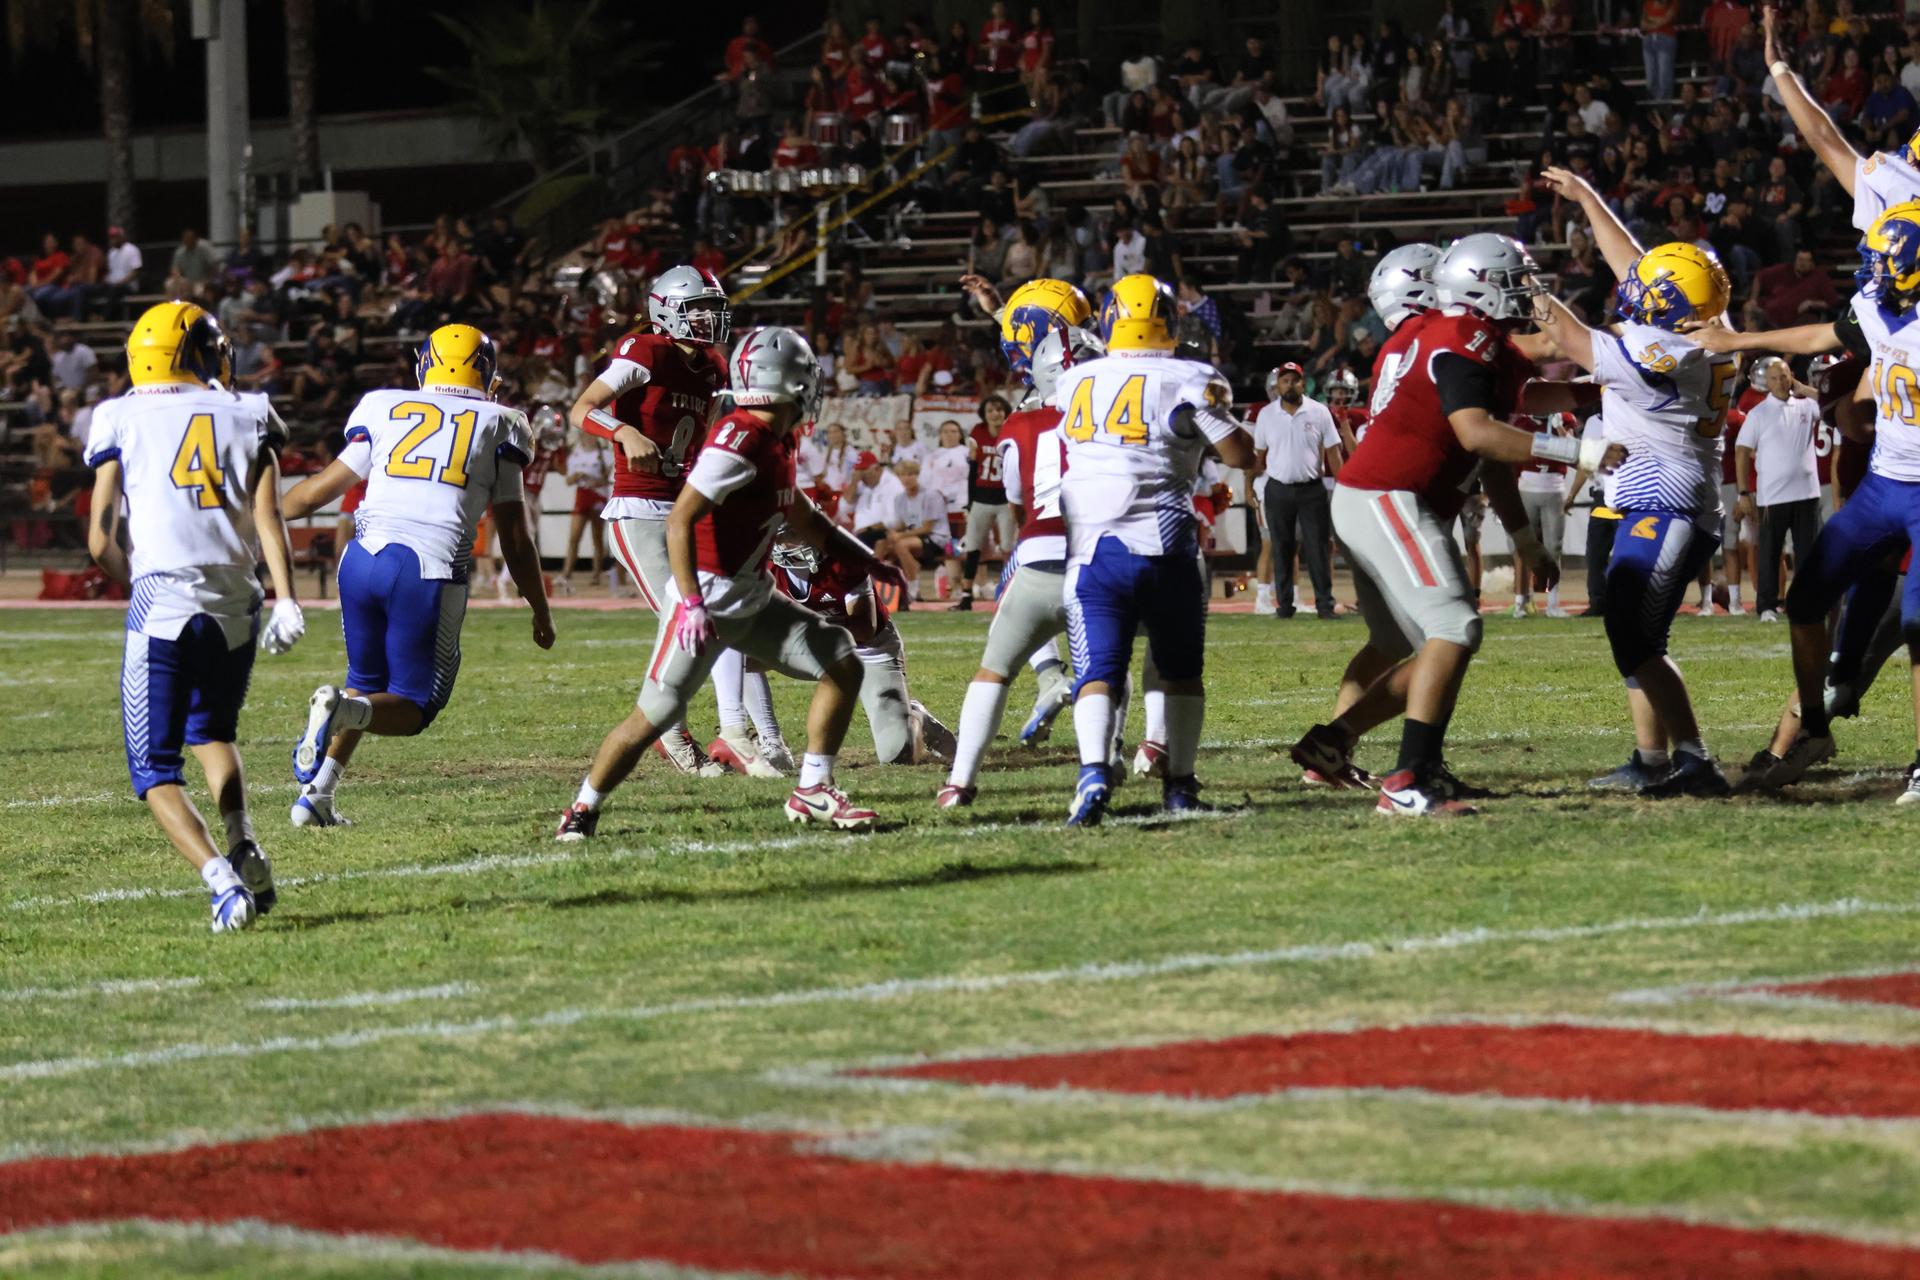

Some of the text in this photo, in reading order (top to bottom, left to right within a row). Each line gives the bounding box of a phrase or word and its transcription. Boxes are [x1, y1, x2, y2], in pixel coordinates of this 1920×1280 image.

[434, 385, 470, 396] Riddell
[1064, 374, 1151, 447] 44
[168, 412, 226, 510] 4
[384, 400, 479, 490] 21
[713, 421, 750, 451] 21
[980, 455, 1003, 482] 15
